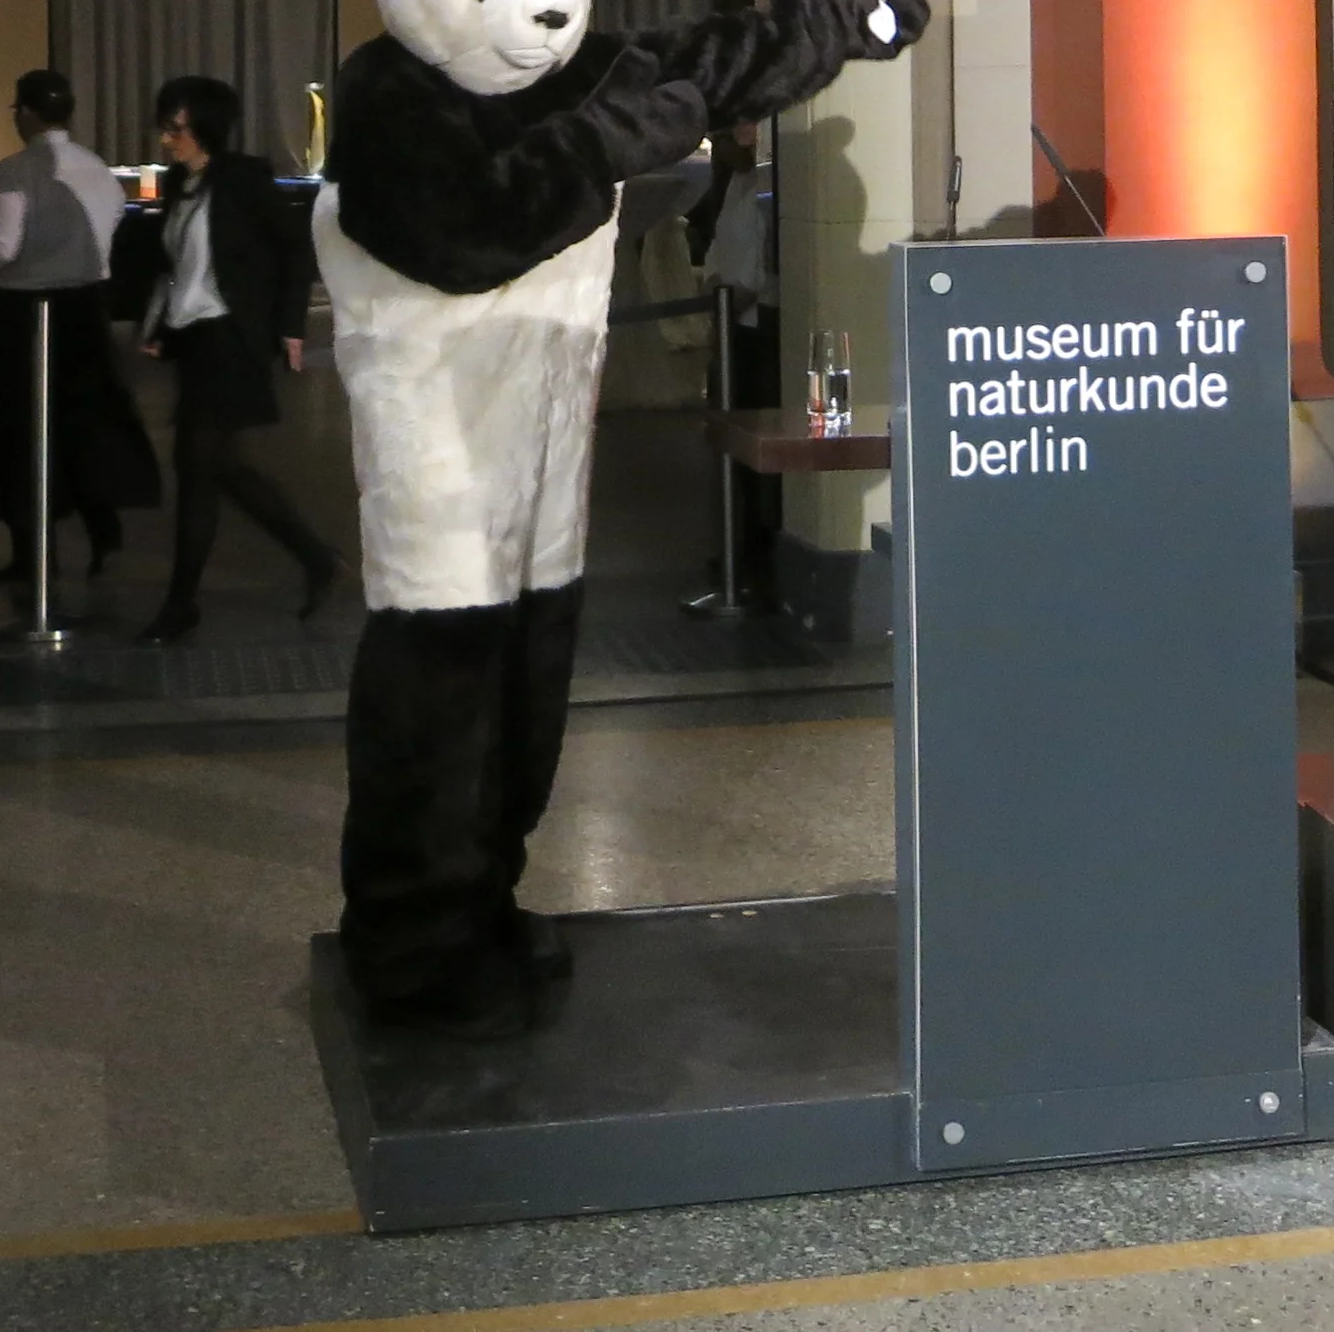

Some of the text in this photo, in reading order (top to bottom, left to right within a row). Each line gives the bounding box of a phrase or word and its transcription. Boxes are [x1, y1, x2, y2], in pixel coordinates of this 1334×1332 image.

[947, 307, 1245, 363] museum für
[949, 362, 1228, 418] naturkunde
[949, 425, 1088, 478] berlin
